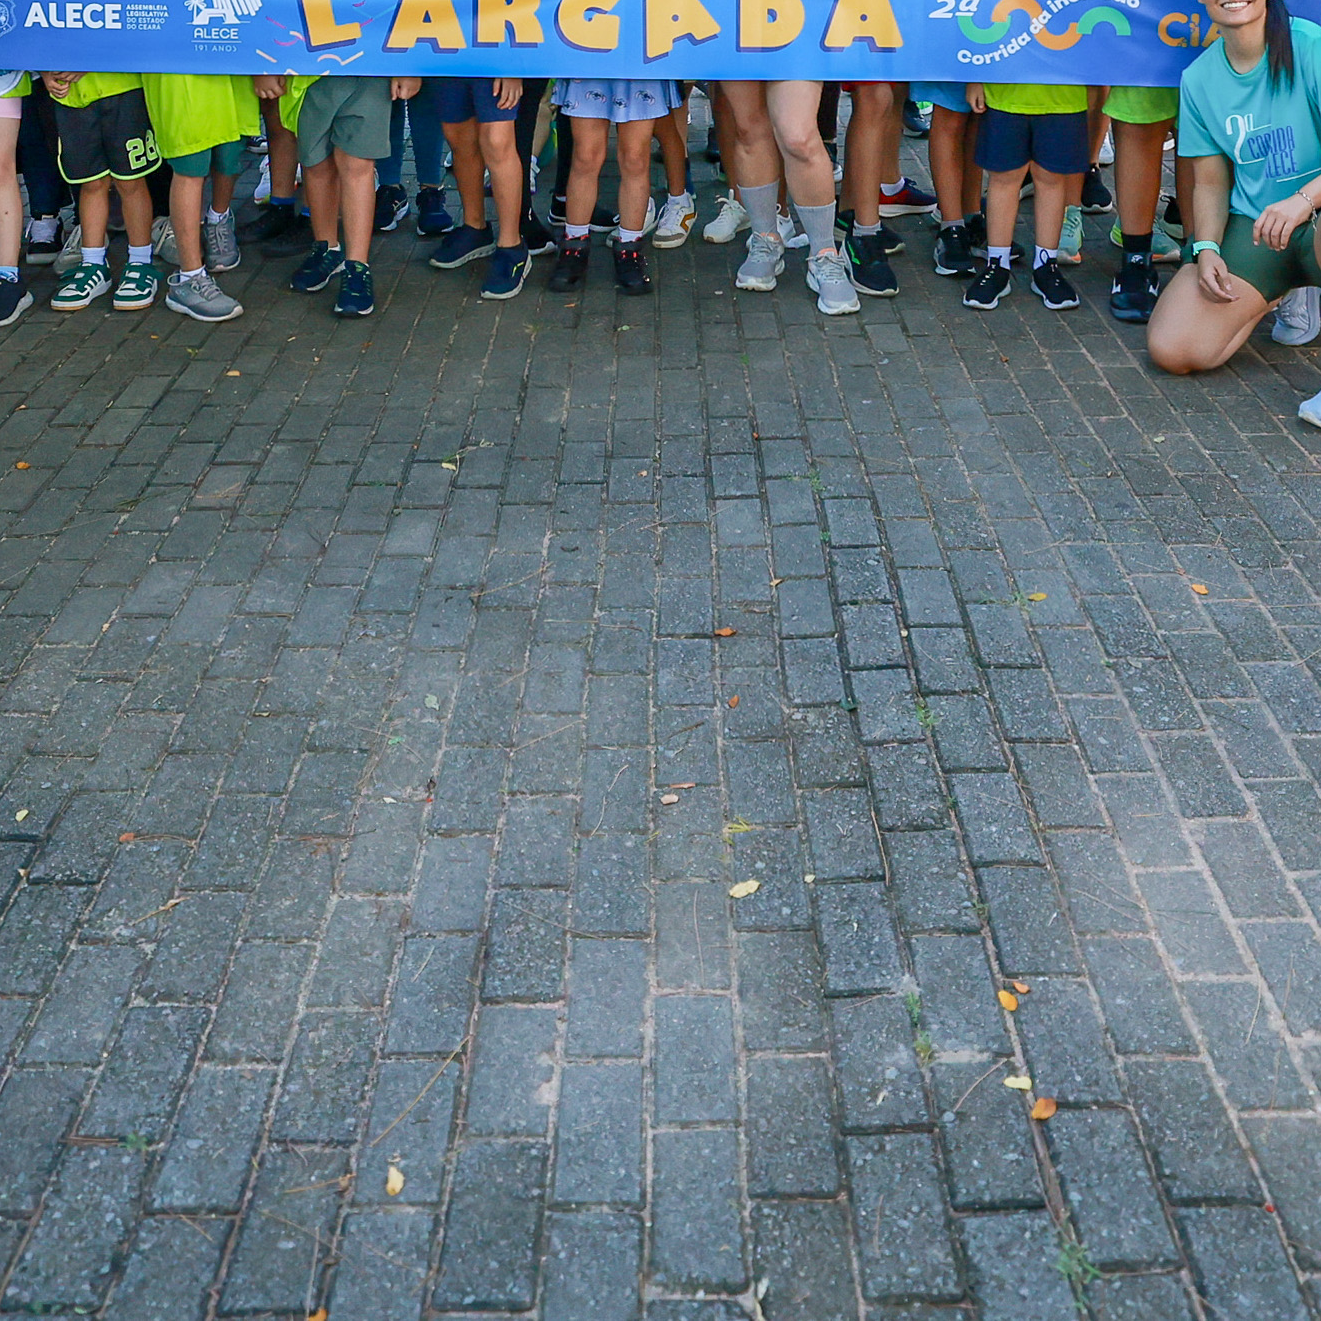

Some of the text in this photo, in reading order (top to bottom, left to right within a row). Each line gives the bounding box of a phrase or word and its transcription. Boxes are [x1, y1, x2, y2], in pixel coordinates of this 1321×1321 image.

[24, 2, 122, 30] ALECE
[194, 27, 239, 39] ALECE
[957, 31, 1032, 66] Corrida
[1029, 10, 1053, 35] da
[125, 129, 159, 170] 28
